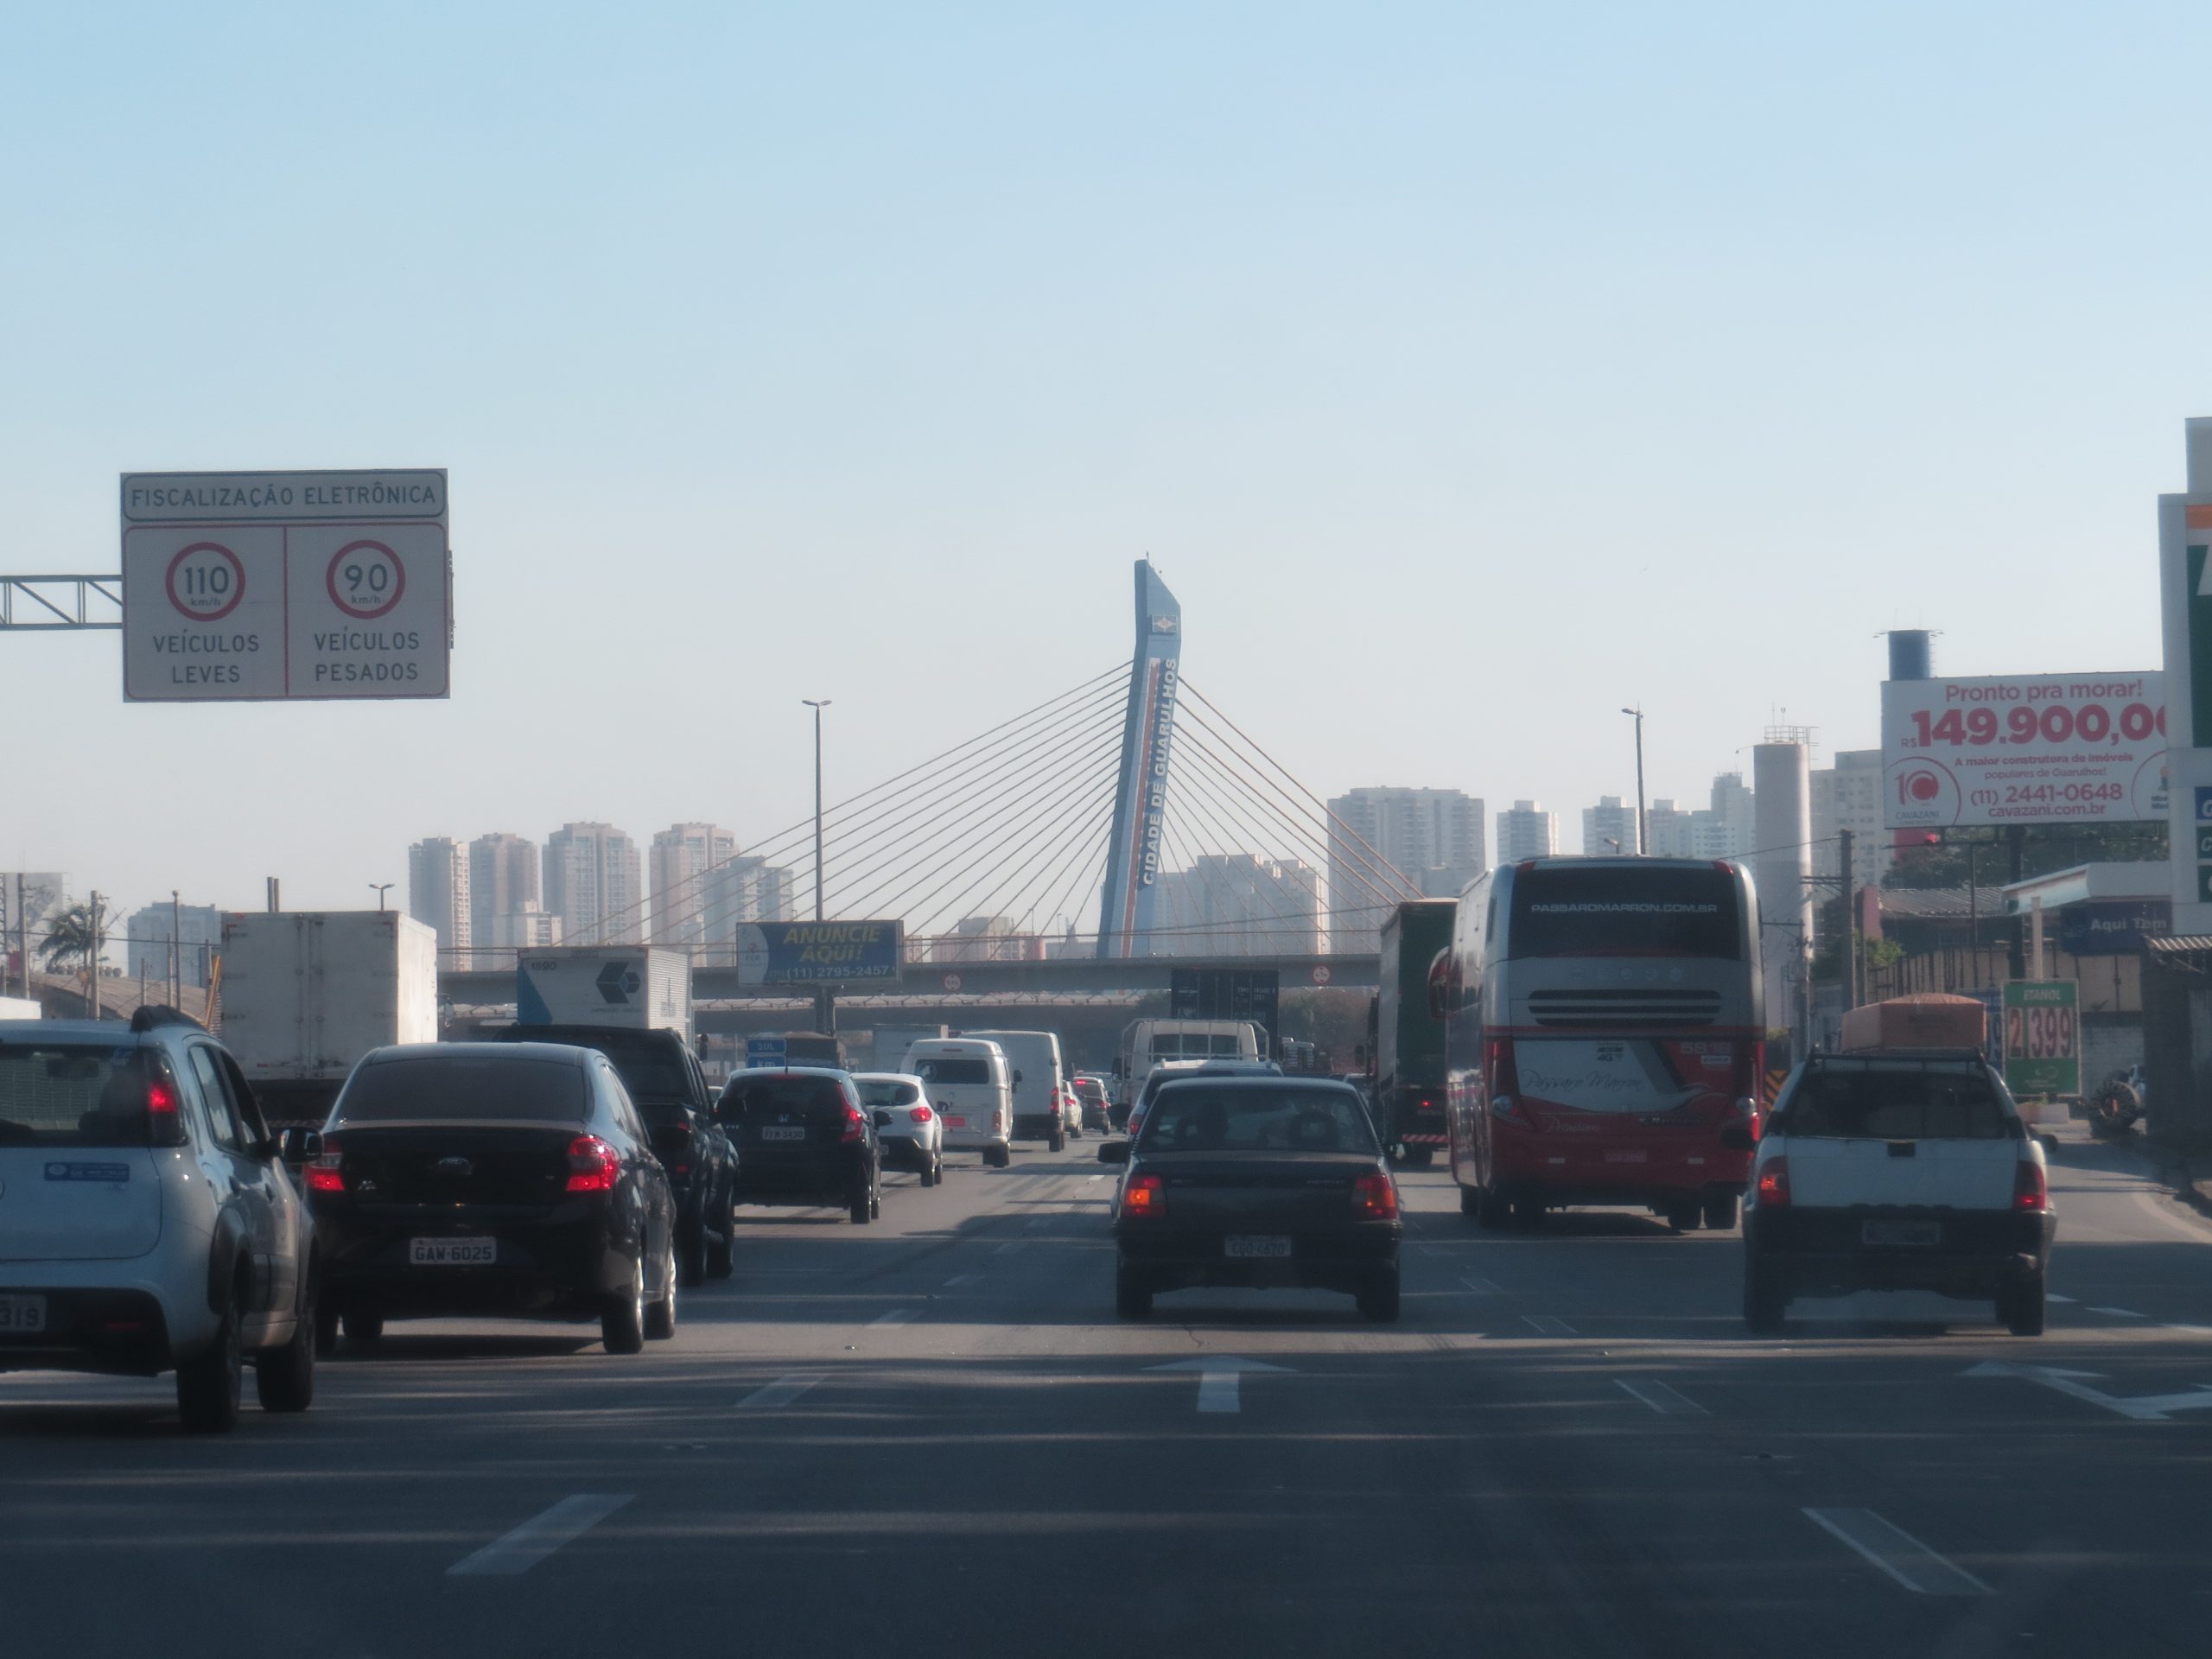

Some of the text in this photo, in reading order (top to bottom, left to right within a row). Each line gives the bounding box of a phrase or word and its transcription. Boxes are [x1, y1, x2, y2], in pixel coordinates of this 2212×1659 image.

[131, 481, 436, 508] FISCALIZAÇÃO ELETRÔNICA
[184, 566, 230, 595] 110
[345, 563, 388, 593] 90
[190, 597, 221, 607] km/h
[351, 594, 382, 605] km/h
[153, 628, 260, 654] VEÍCULOS
[314, 626, 420, 652] VEÍCULOS
[172, 664, 241, 684] LEVES
[315, 663, 419, 682] PESADOS
[1945, 678, 2143, 703] Pronto pra morar!
[1901, 702, 2166, 748] R$ 149.900,0
[1955, 757, 1964, 767] A
[2002, 753, 2069, 766] construtora
[2071, 752, 2086, 764] de
[1143, 658, 1176, 886] CIDADE DE GUARULHOS
[2037, 767, 2050, 779] de
[1970, 782, 2124, 806] (11) 2441-0648
[1988, 802, 2107, 817] cavazani.com.br
[1530, 903, 1718, 913] PASSAROMARRON.COM.BR
[783, 925, 881, 944] ANUNCIE
[2091, 918, 2127, 933] Aqui
[799, 944, 864, 964] AQUI!
[786, 967, 813, 980] (11)
[817, 965, 889, 977] 2795-2457
[2024, 989, 2062, 1001] ETANOL
